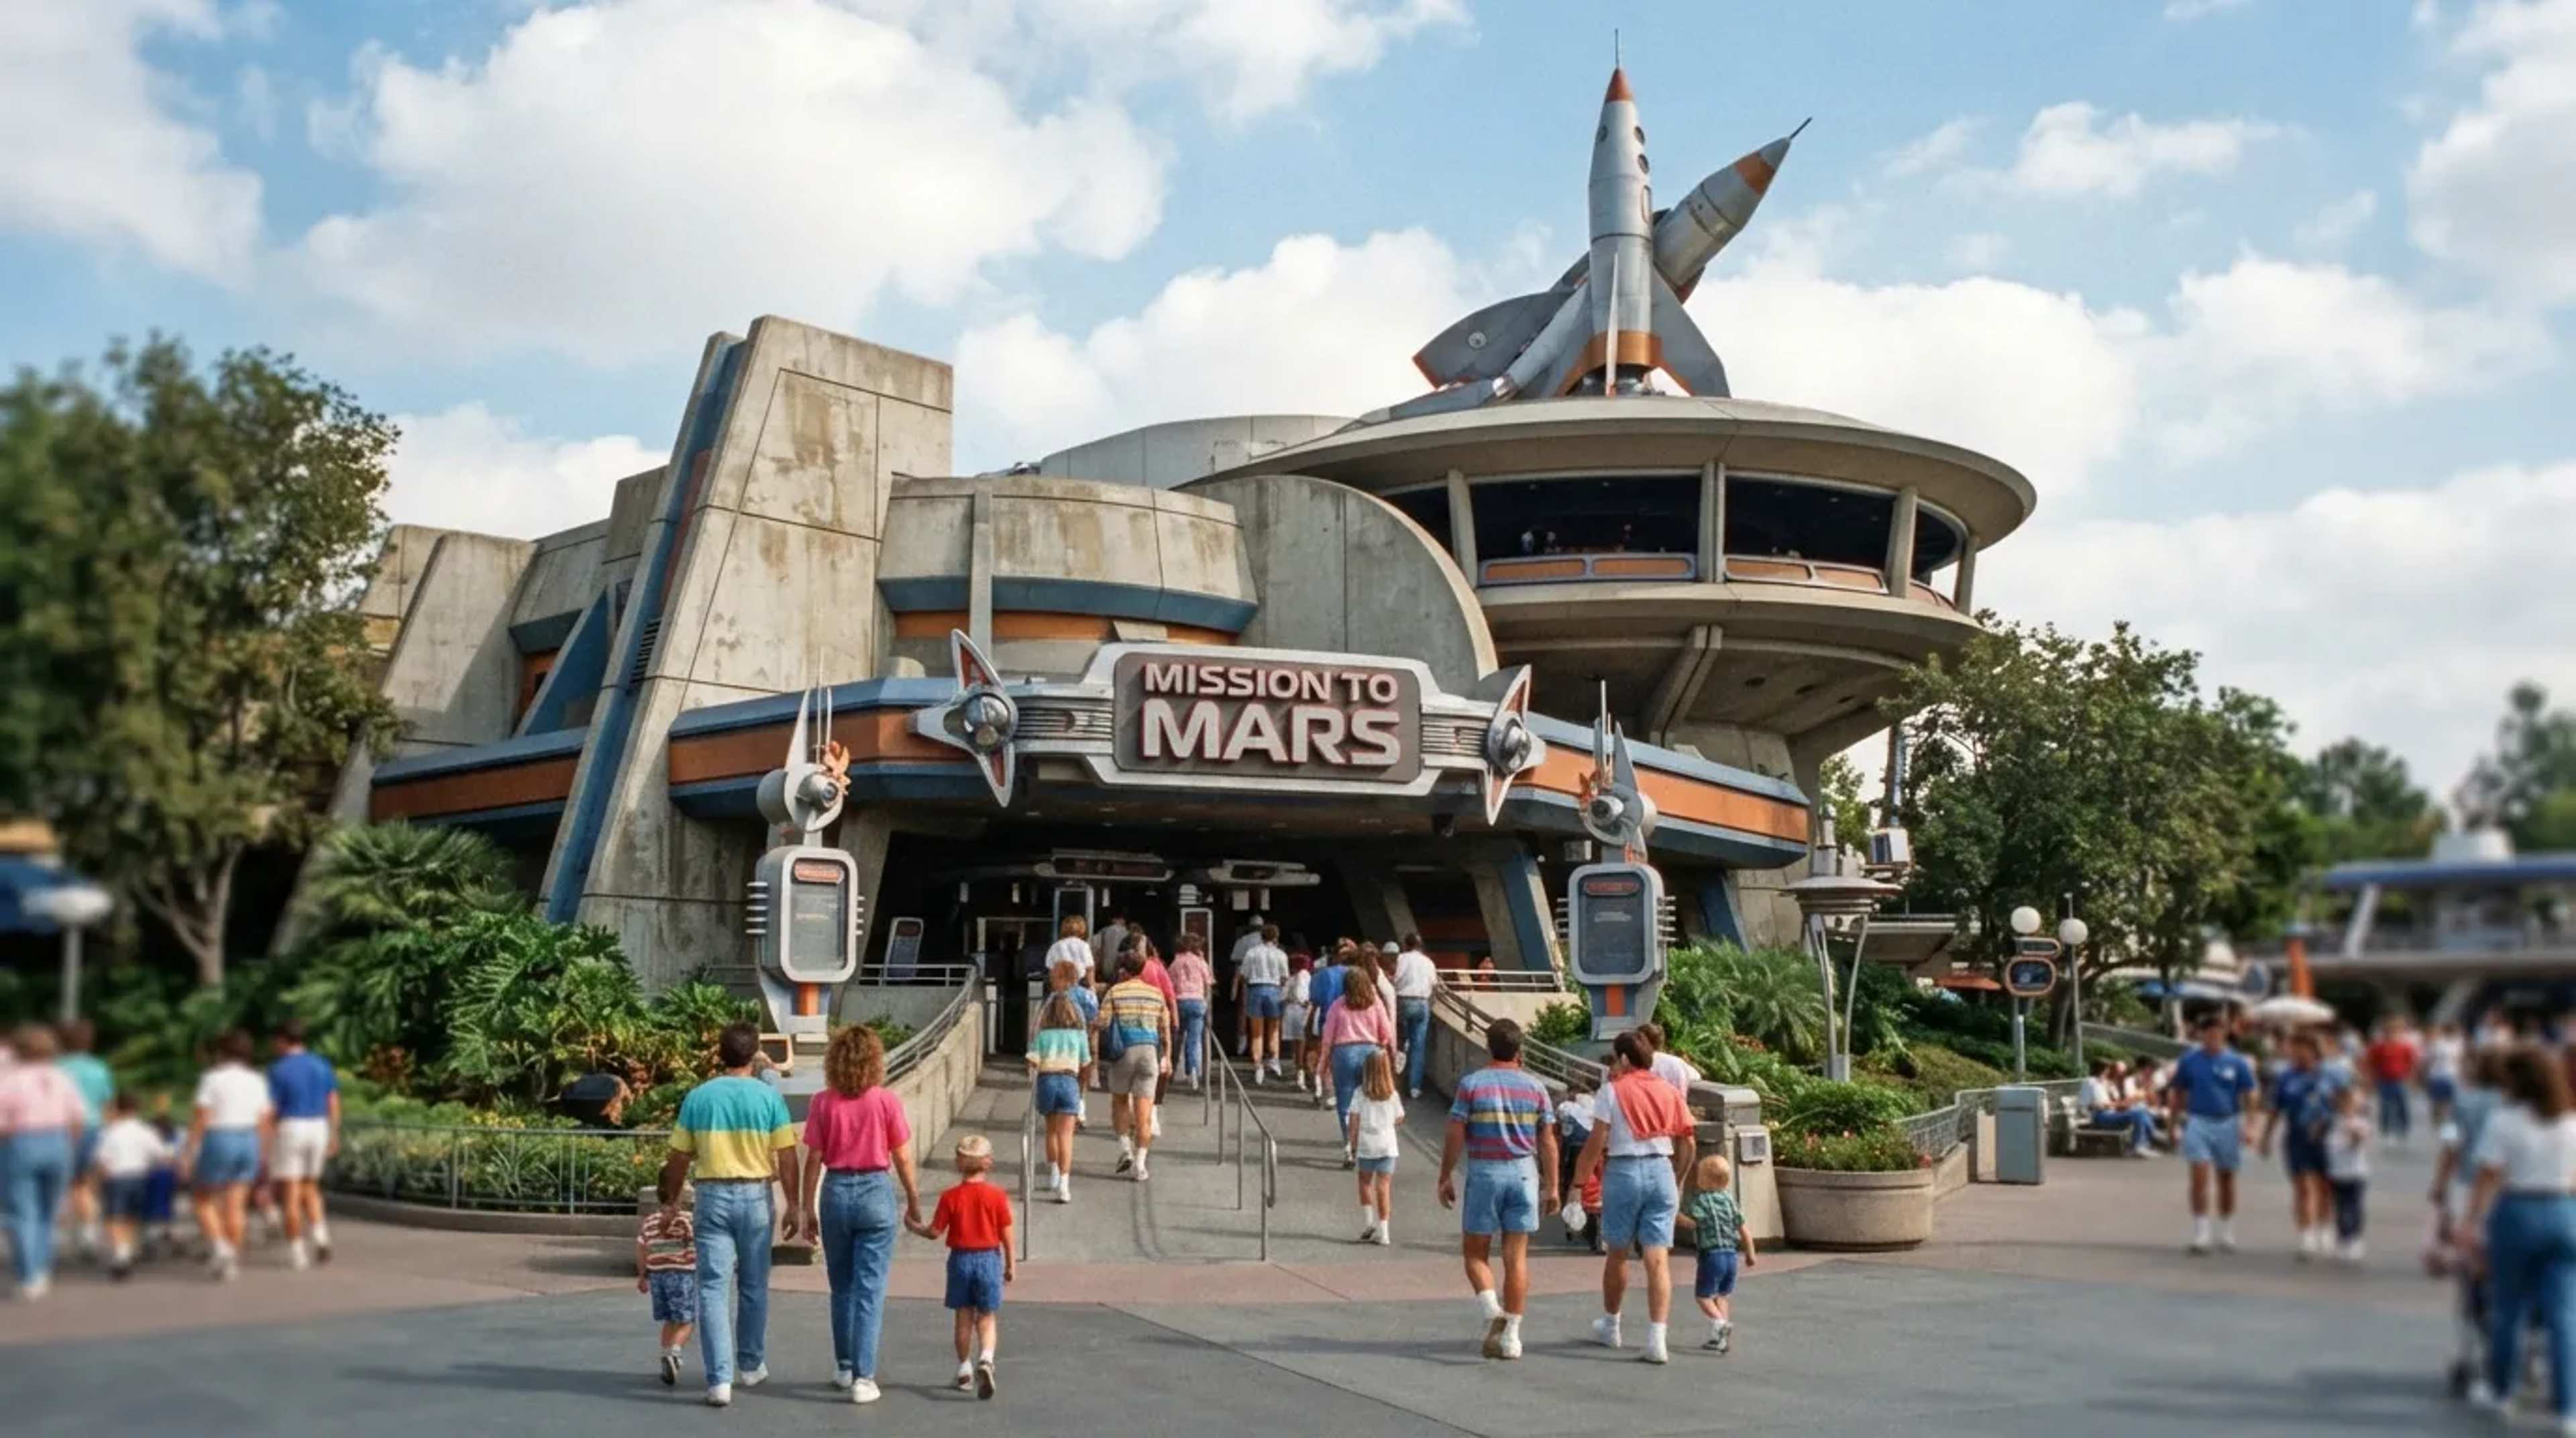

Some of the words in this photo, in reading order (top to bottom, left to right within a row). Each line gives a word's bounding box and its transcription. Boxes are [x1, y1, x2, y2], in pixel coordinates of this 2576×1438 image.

[1144, 662, 1332, 701] MISSION
[1341, 671, 1399, 703] TO
[1142, 697, 1401, 766] MARS
